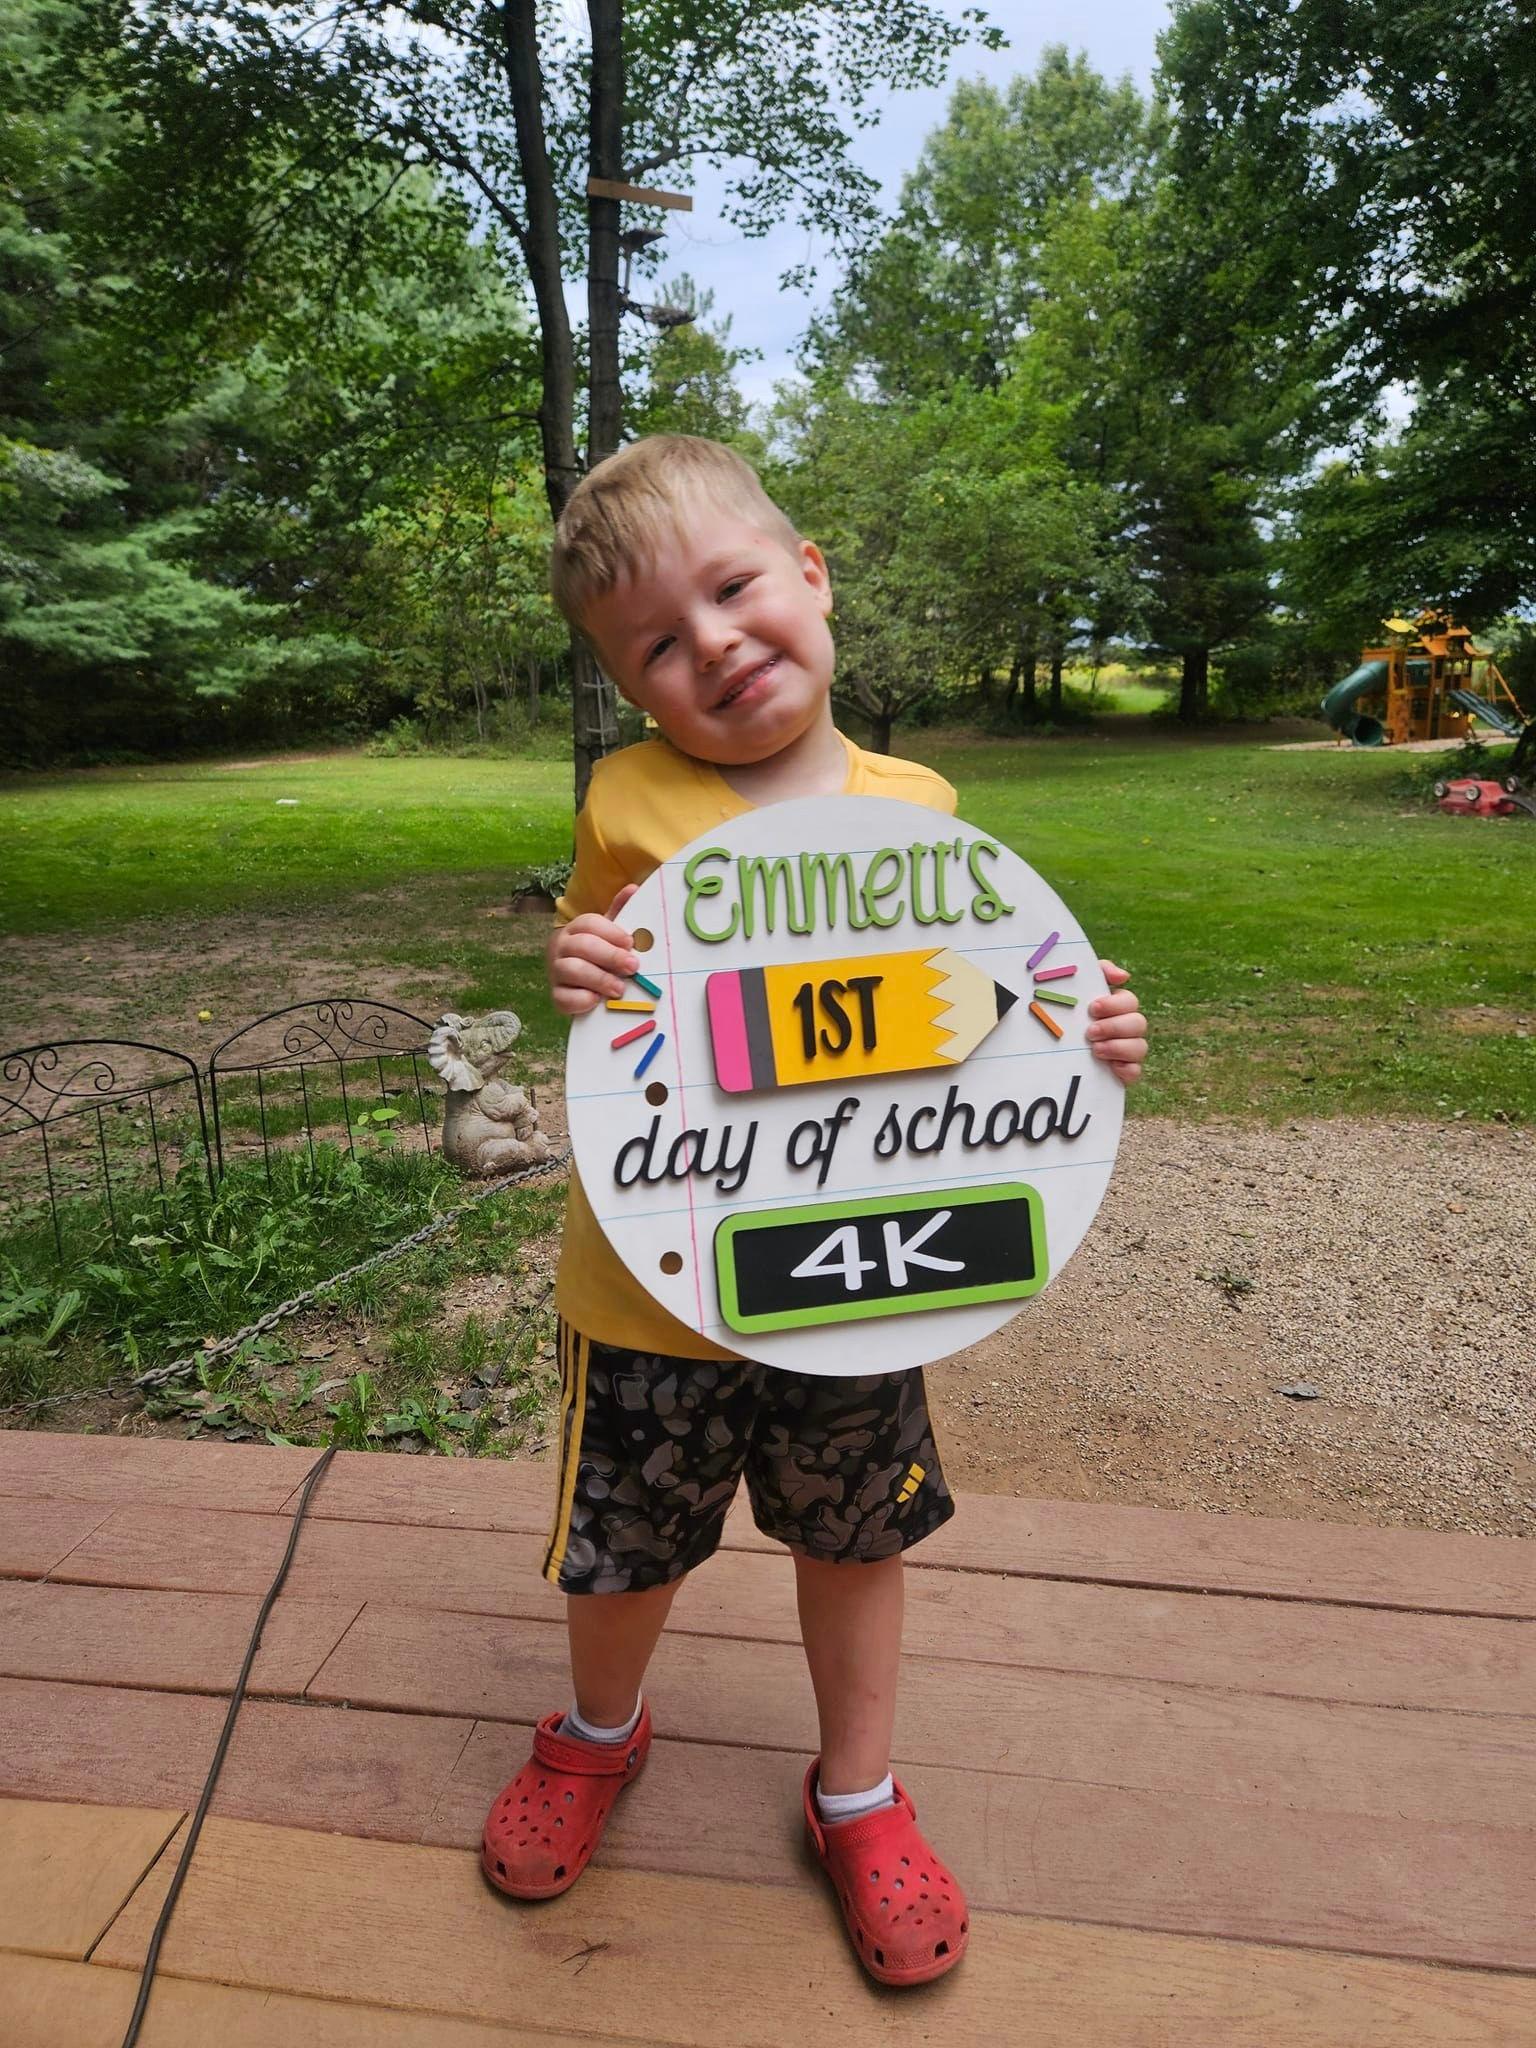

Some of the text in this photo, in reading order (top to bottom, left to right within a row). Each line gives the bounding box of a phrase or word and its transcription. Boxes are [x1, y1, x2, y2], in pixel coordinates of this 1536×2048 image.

[685, 838, 1015, 942] Emmett's
[793, 976, 884, 1060] 1ST
[614, 1075, 1091, 1192] day of school
[790, 1210, 966, 1291] 4K
